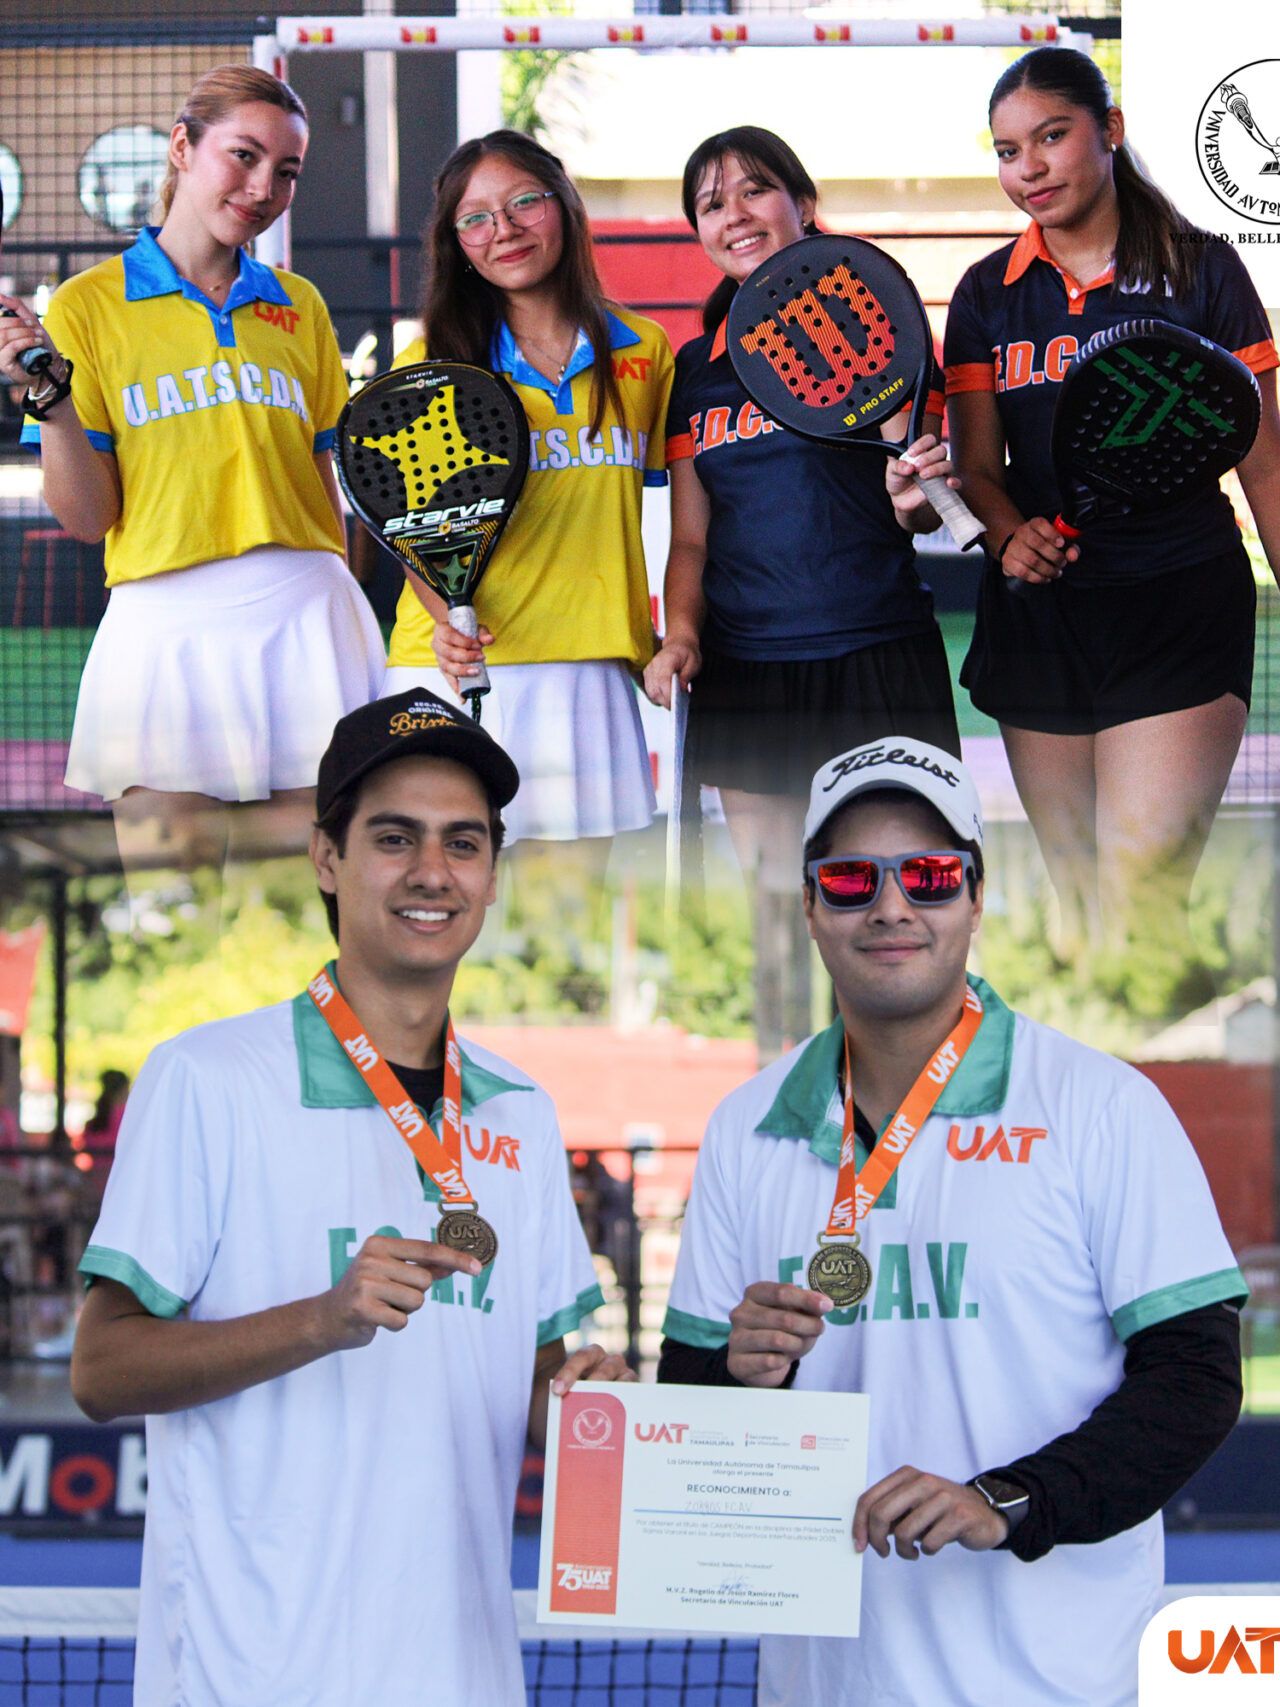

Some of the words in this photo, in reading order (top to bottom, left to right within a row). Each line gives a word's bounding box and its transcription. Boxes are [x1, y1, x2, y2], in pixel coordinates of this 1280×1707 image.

[860, 397, 879, 415] PRO
[878, 377, 904, 401] STAFF
[384, 498, 506, 532] starvie
[822, 745, 960, 793] Titleist
[344, 1034, 379, 1072] UAT
[927, 1040, 961, 1085] UAT
[388, 1100, 424, 1138] UAT
[883, 1114, 917, 1154] UAT
[946, 1124, 1049, 1164] UAT
[448, 1224, 481, 1240] UAT
[821, 1260, 857, 1275] UAT
[634, 1422, 690, 1445] UAT
[678, 1458, 722, 1468] Universidad
[724, 1460, 764, 1469] Autónoma
[765, 1462, 774, 1470] de
[776, 1463, 820, 1473] Tamaulipas
[686, 1484, 780, 1497] RECONOCIMIENTO
[556, 1562, 583, 1592] 75
[582, 1567, 612, 1585] UAT
[718, 1597, 726, 1605] de
